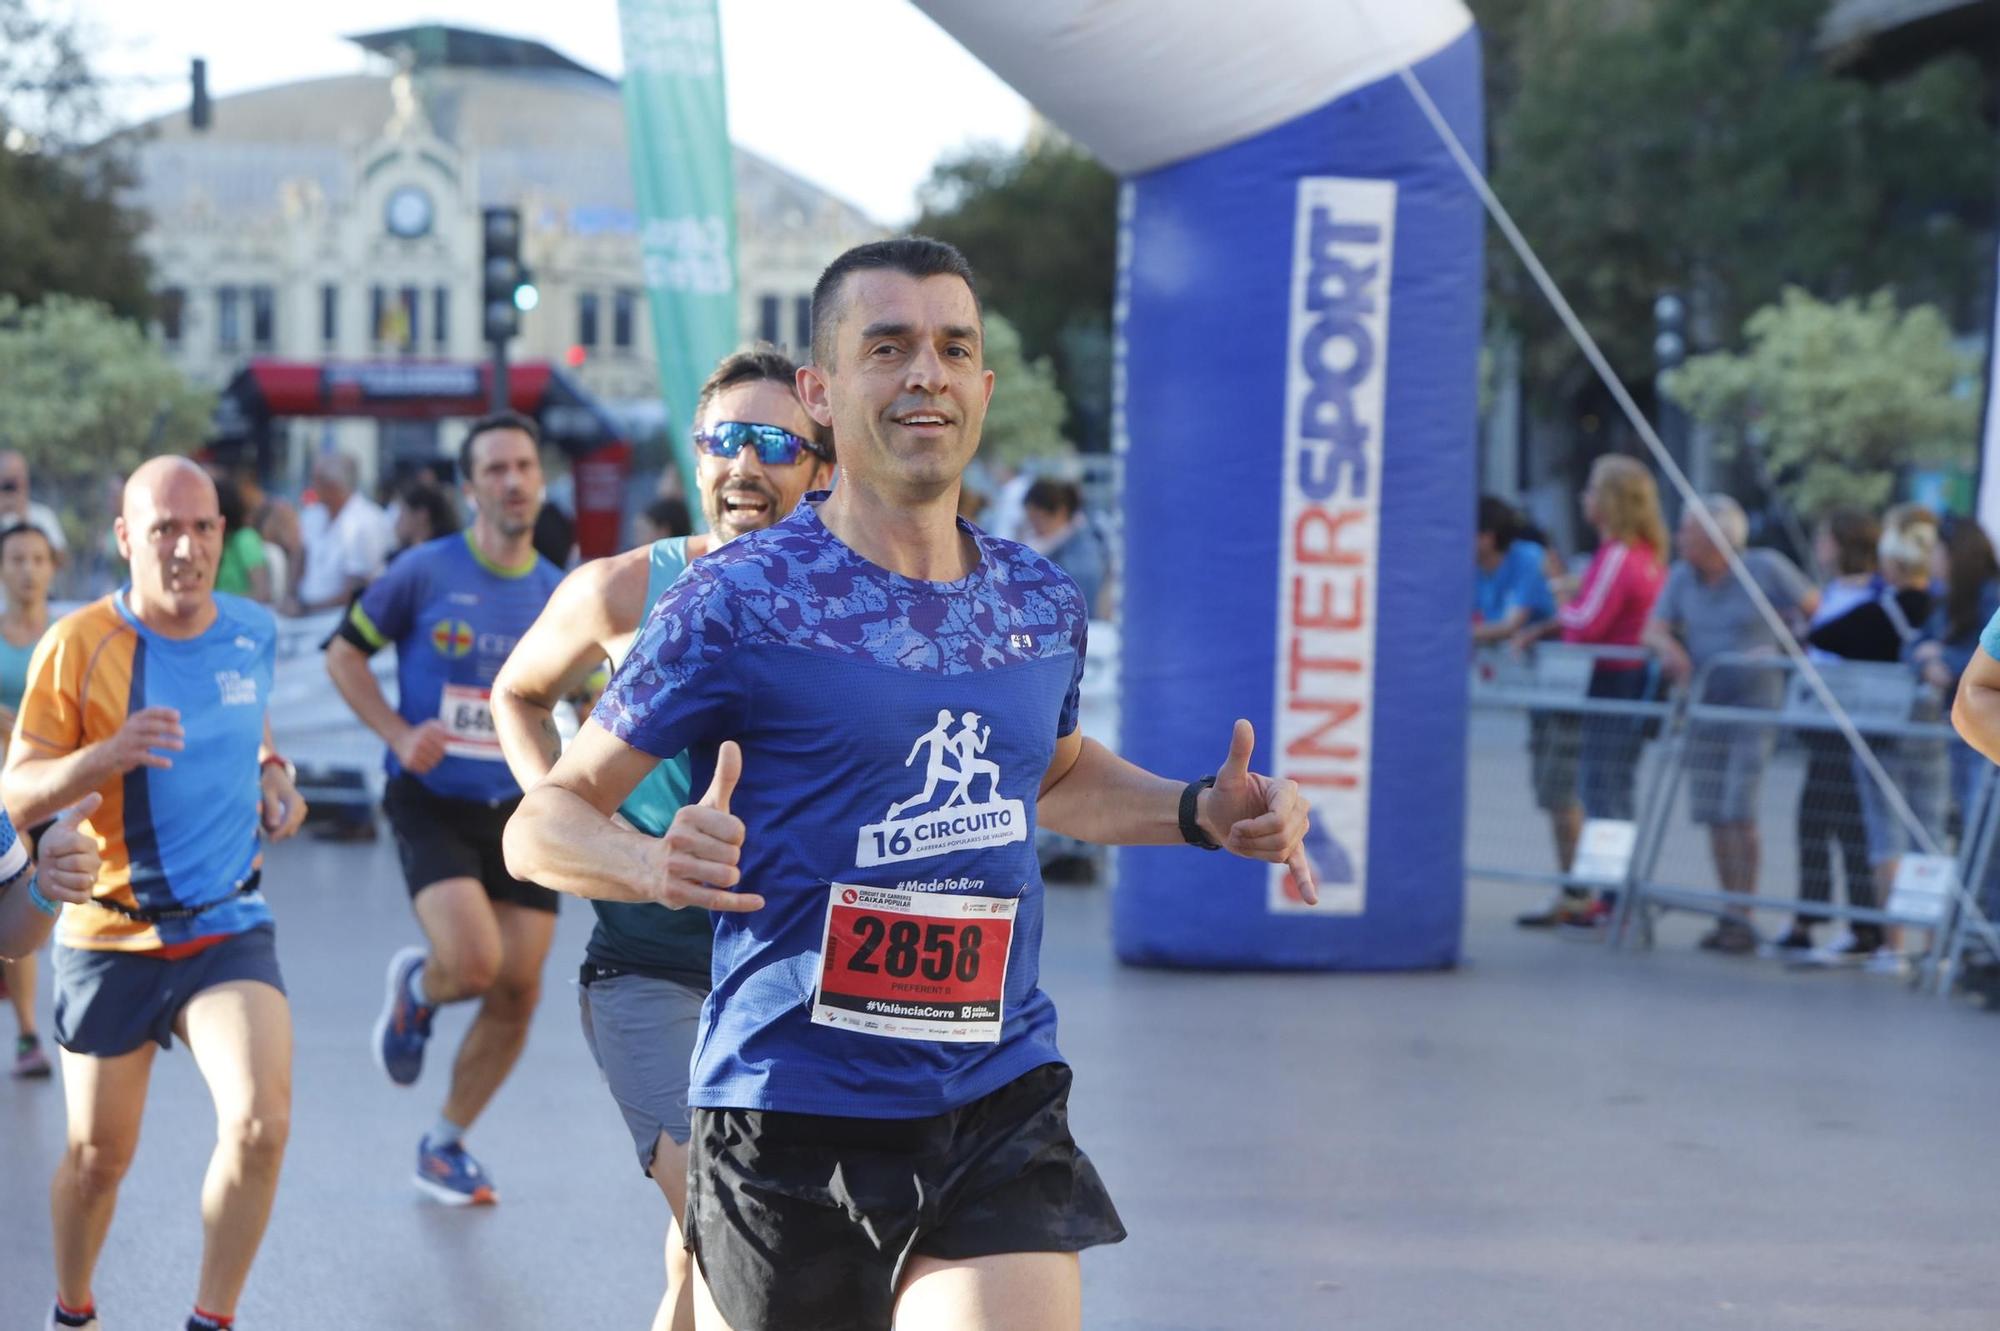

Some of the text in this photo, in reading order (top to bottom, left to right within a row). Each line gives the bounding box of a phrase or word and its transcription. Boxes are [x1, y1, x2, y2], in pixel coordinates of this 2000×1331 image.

[1286, 206, 1381, 789] INTERSPORT
[914, 809, 1012, 841] CIRCUITO
[873, 828, 911, 858] 16
[896, 877, 984, 893] #MadeToRun
[858, 895, 912, 907] CAIXA POPULAR
[846, 915, 983, 983] 2858
[891, 983, 942, 995] PREFERENT
[866, 1000, 955, 1019] #ValènciaCorre
